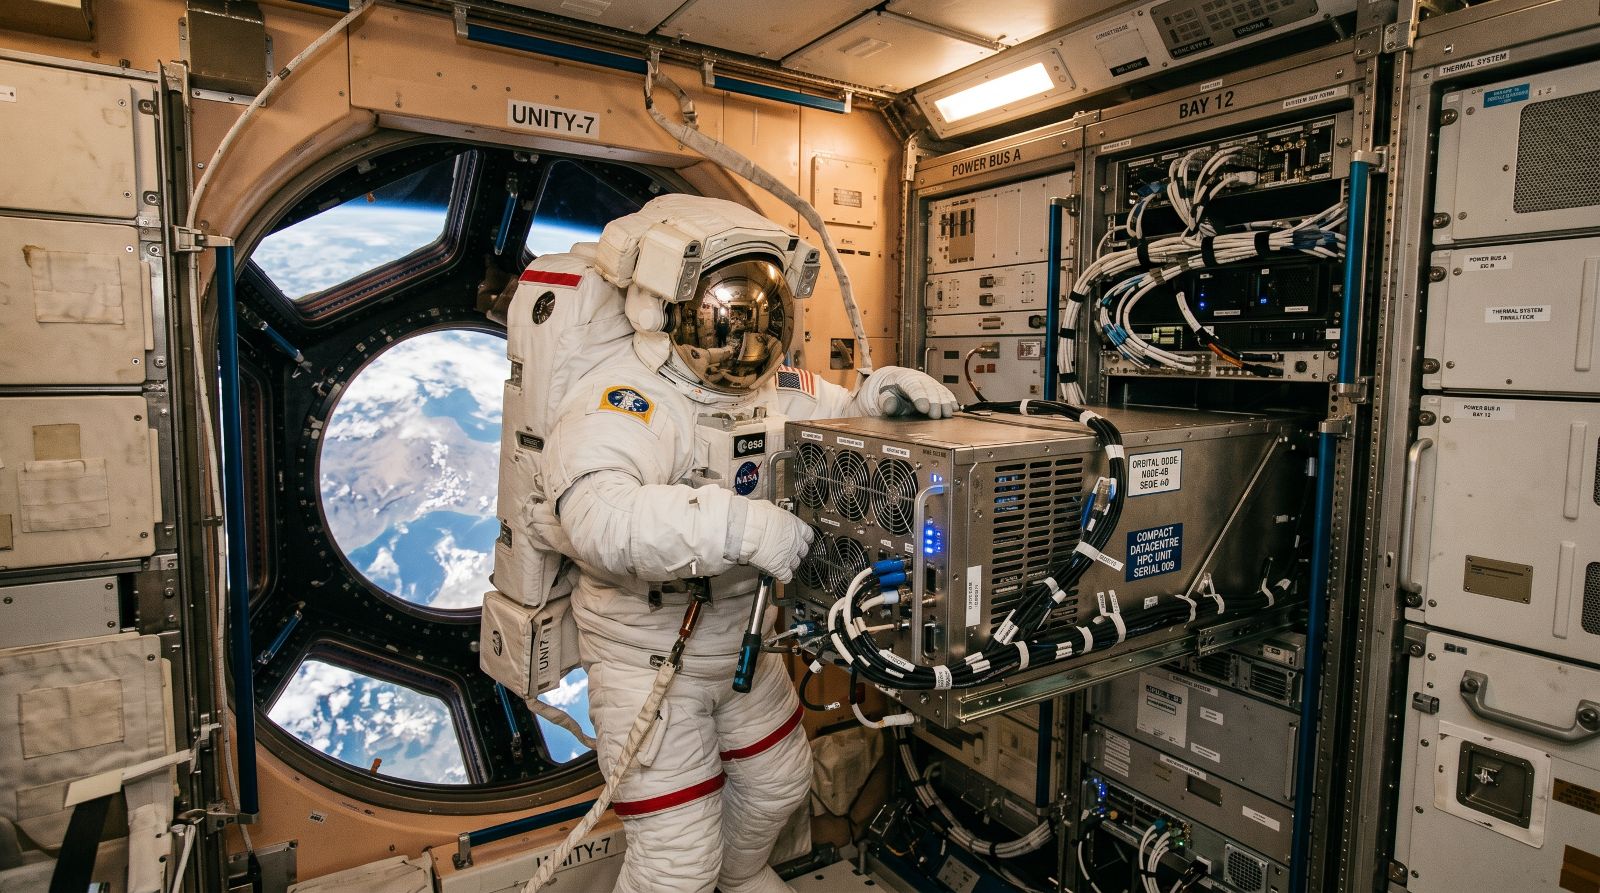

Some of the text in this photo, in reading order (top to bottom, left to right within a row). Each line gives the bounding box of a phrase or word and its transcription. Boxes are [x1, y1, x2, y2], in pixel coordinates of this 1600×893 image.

[1442, 52, 1508, 74] THERMAL SYSTEM
[1179, 90, 1234, 119] BAY 12
[512, 104, 595, 134] UNITY-7
[952, 148, 1022, 177] POWER BUS A
[747, 439, 763, 450] esa
[1132, 458, 1160, 468] ORBITAL
[736, 473, 758, 485] NASA
[1136, 526, 1174, 542] COMPACT
[1130, 536, 1180, 555] DATACENTRE
[1136, 549, 1172, 566] HPC UNIT
[1133, 560, 1175, 578] SERIAL 009
